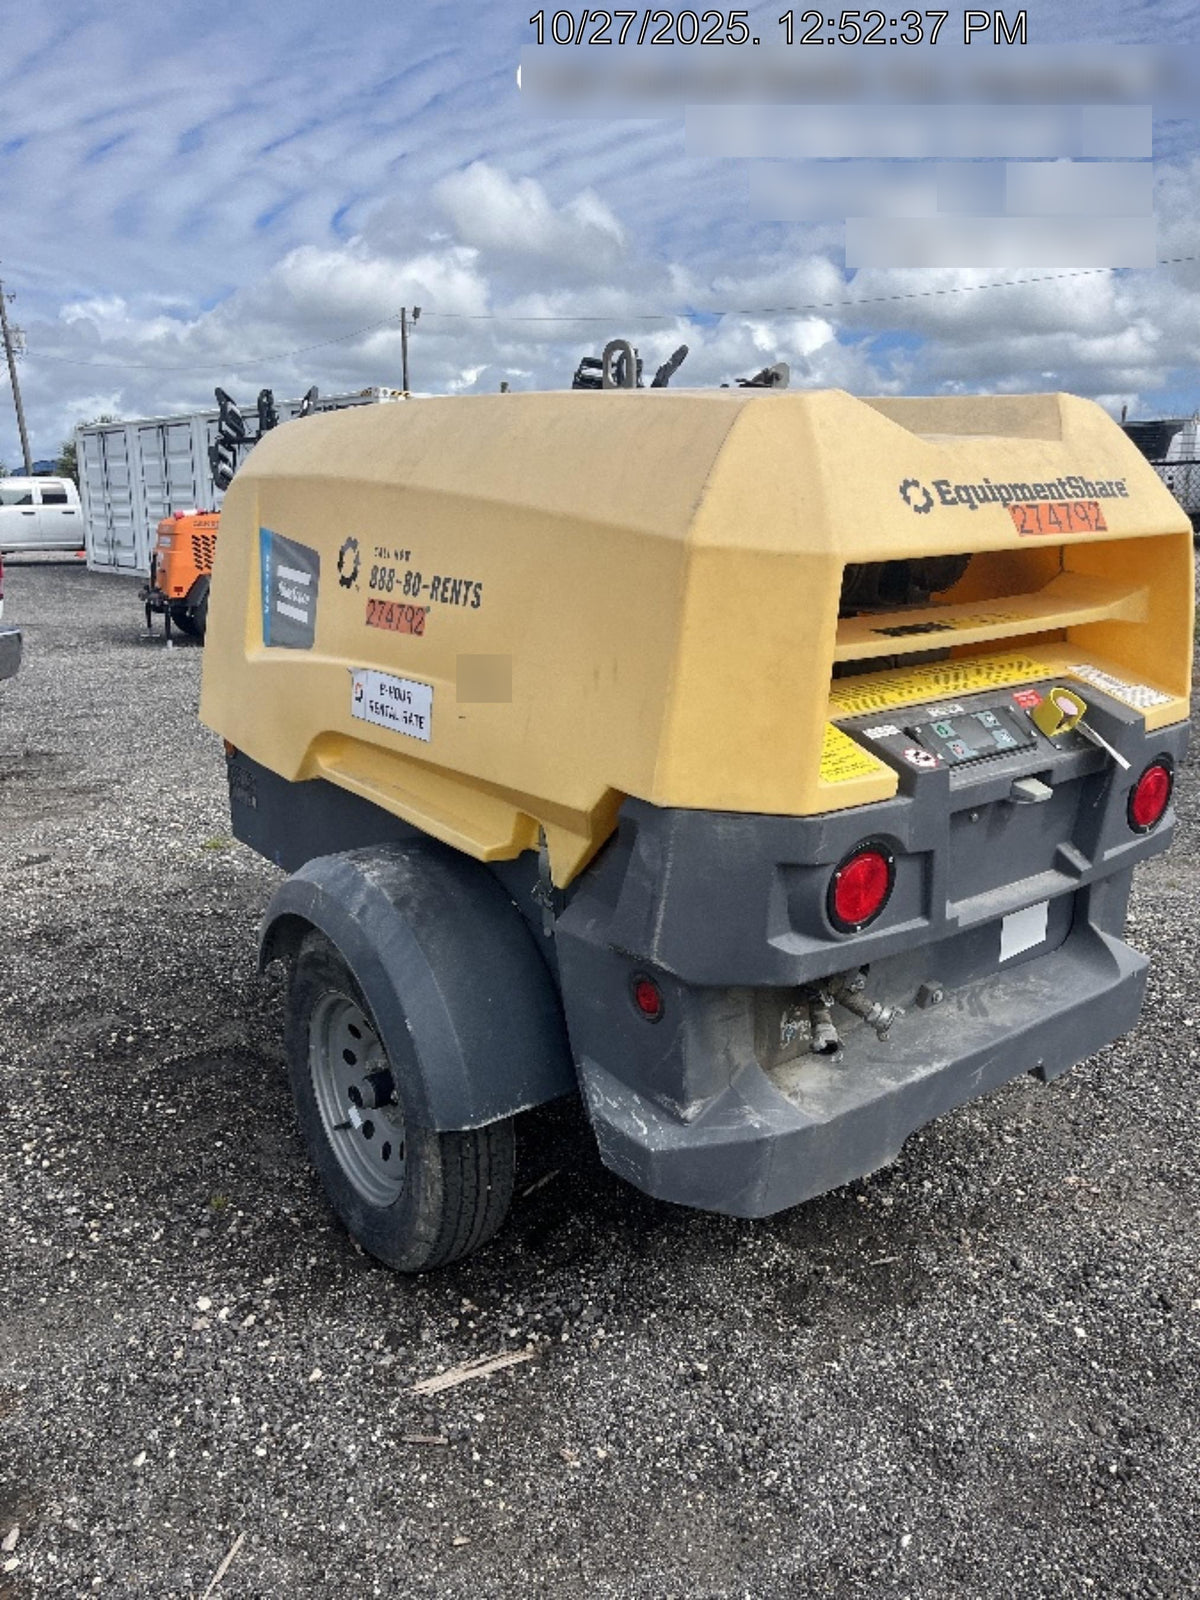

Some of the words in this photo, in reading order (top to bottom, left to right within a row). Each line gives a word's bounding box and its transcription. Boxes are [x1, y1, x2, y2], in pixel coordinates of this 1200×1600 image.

[932, 476, 1128, 510] EquipmentShare
[1011, 501, 1108, 534] 274792
[369, 564, 483, 609] 888-80-RENTS
[366, 599, 425, 636] 274792
